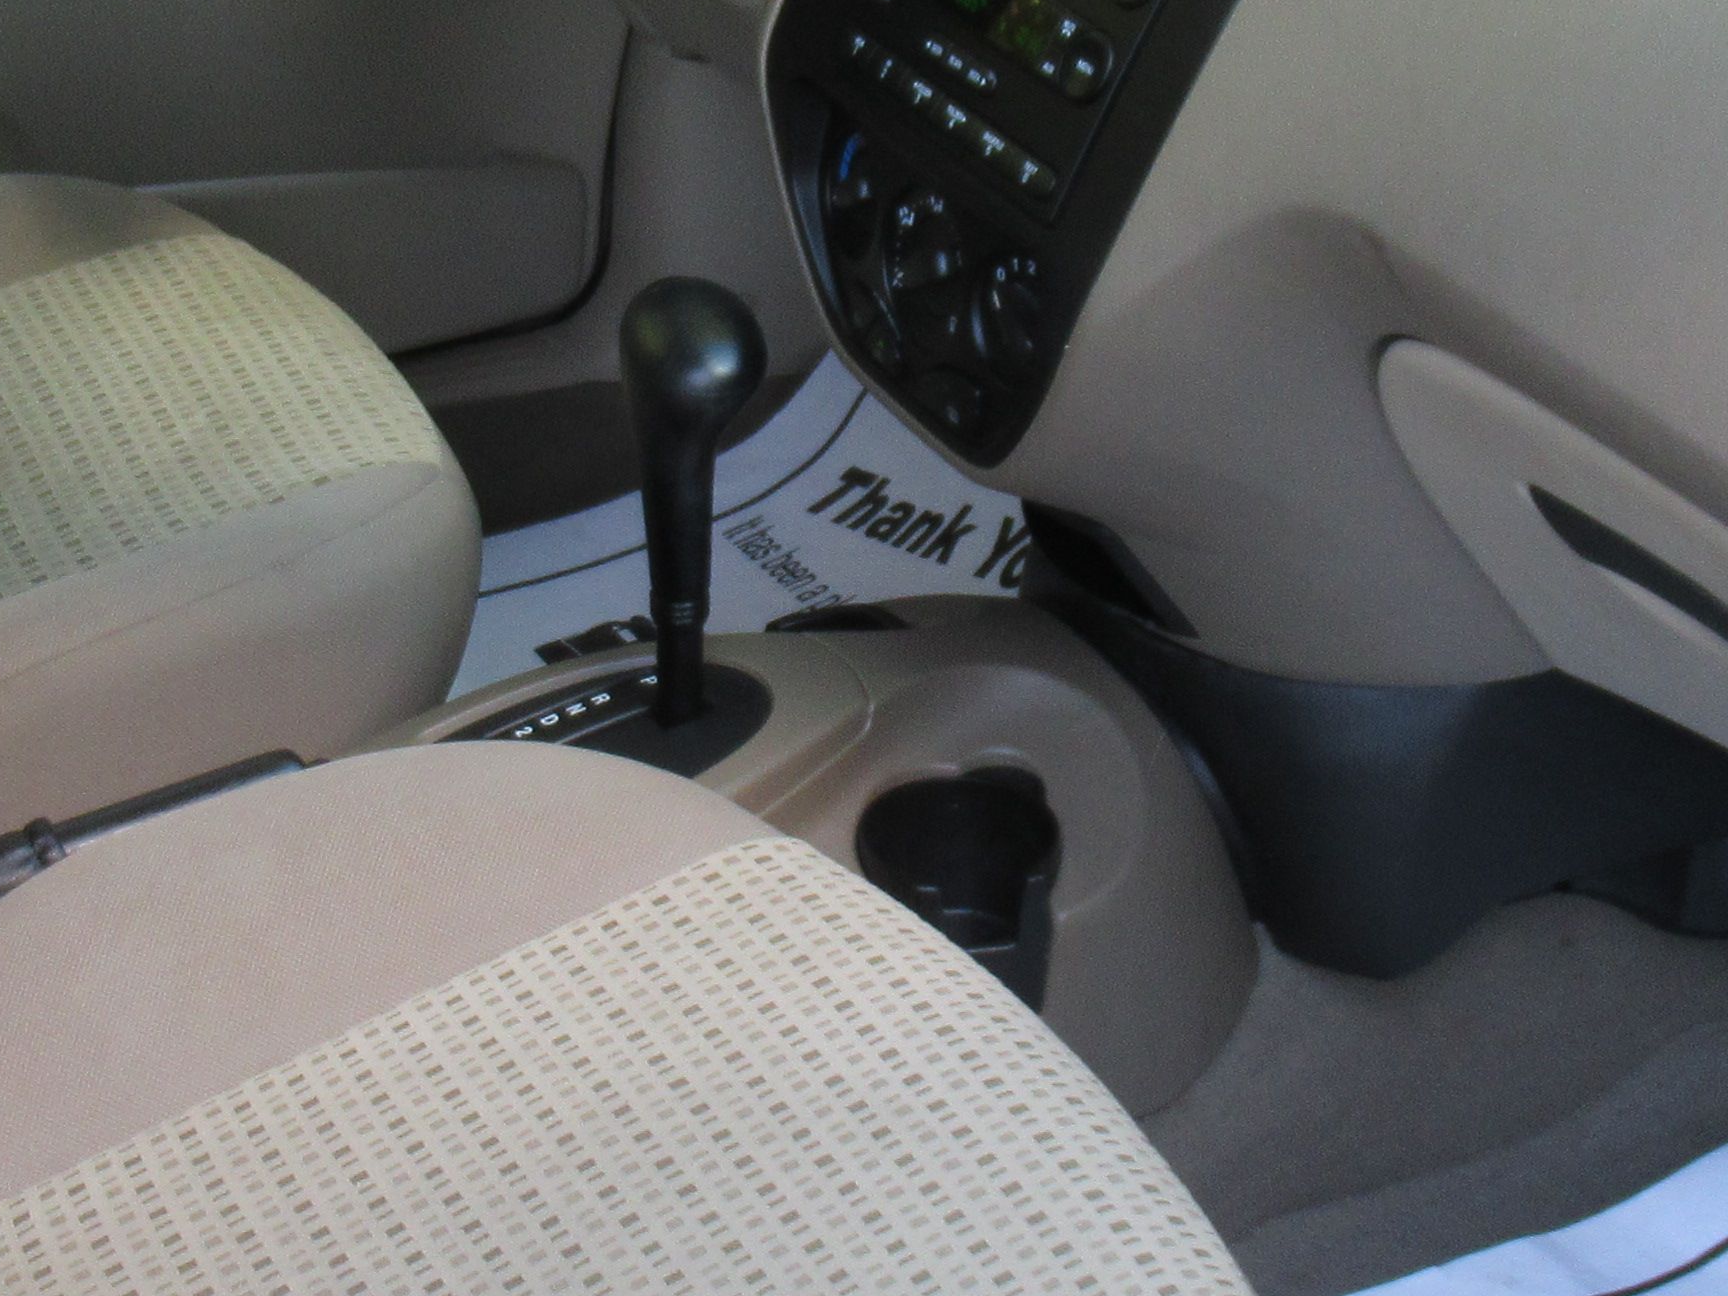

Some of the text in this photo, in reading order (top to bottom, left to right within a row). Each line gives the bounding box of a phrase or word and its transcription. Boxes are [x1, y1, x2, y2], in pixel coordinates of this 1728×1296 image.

[724, 515, 764, 541] It
[808, 466, 976, 565] Thank
[734, 525, 781, 562] has
[761, 547, 817, 592] been
[515, 675, 657, 738] P R N D 2
